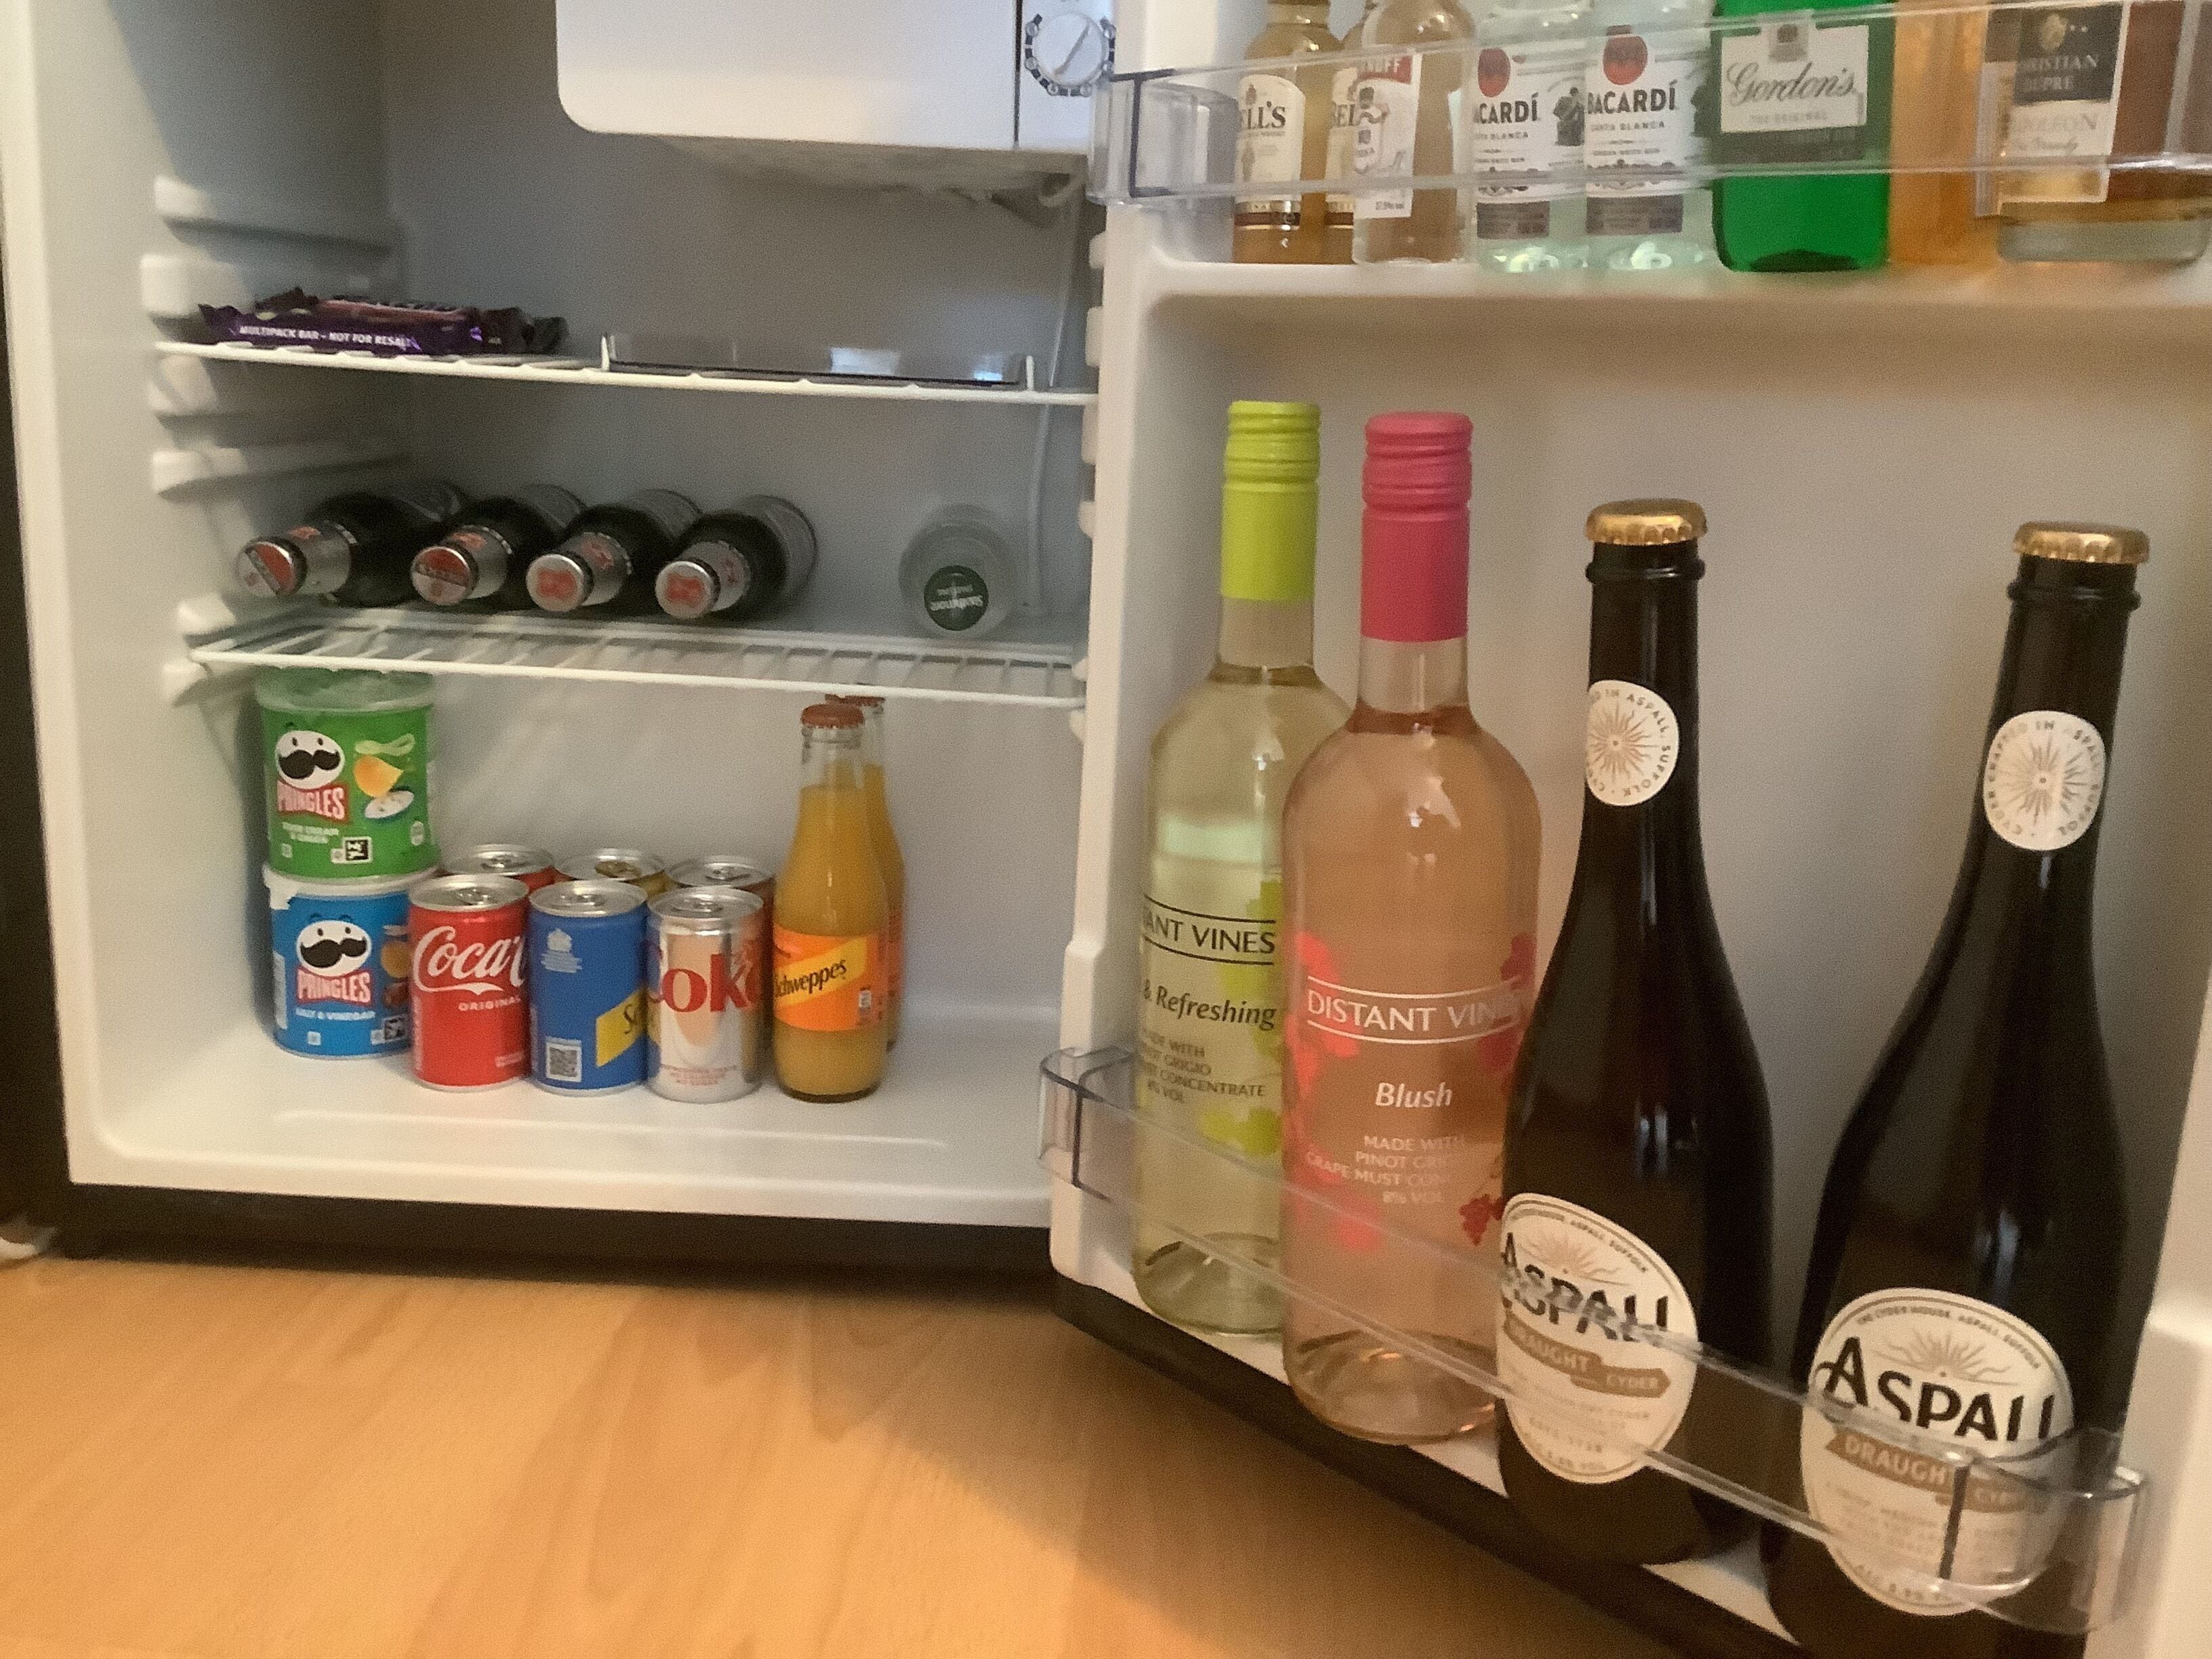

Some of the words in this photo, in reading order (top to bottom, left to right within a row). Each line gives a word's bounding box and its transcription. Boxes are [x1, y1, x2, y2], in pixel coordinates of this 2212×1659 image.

[1726, 62, 1856, 106] Gordon's
[298, 329, 321, 340] BAR
[329, 331, 350, 343] NOT
[352, 333, 372, 344] FOR
[1192, 924, 1275, 954] VINES
[1156, 985, 1276, 1031] Refreshing
[1307, 989, 1437, 1031] DISTANT
[1160, 1069, 1266, 1097] CONCENTRATE
[1375, 1083, 1452, 1109] Blush
[1364, 1135, 1414, 1151] MADE
[1355, 1151, 1407, 1169] PINOT
[1355, 1169, 1403, 1187] MUST
[1844, 1435, 1949, 1487] DRAUGH
